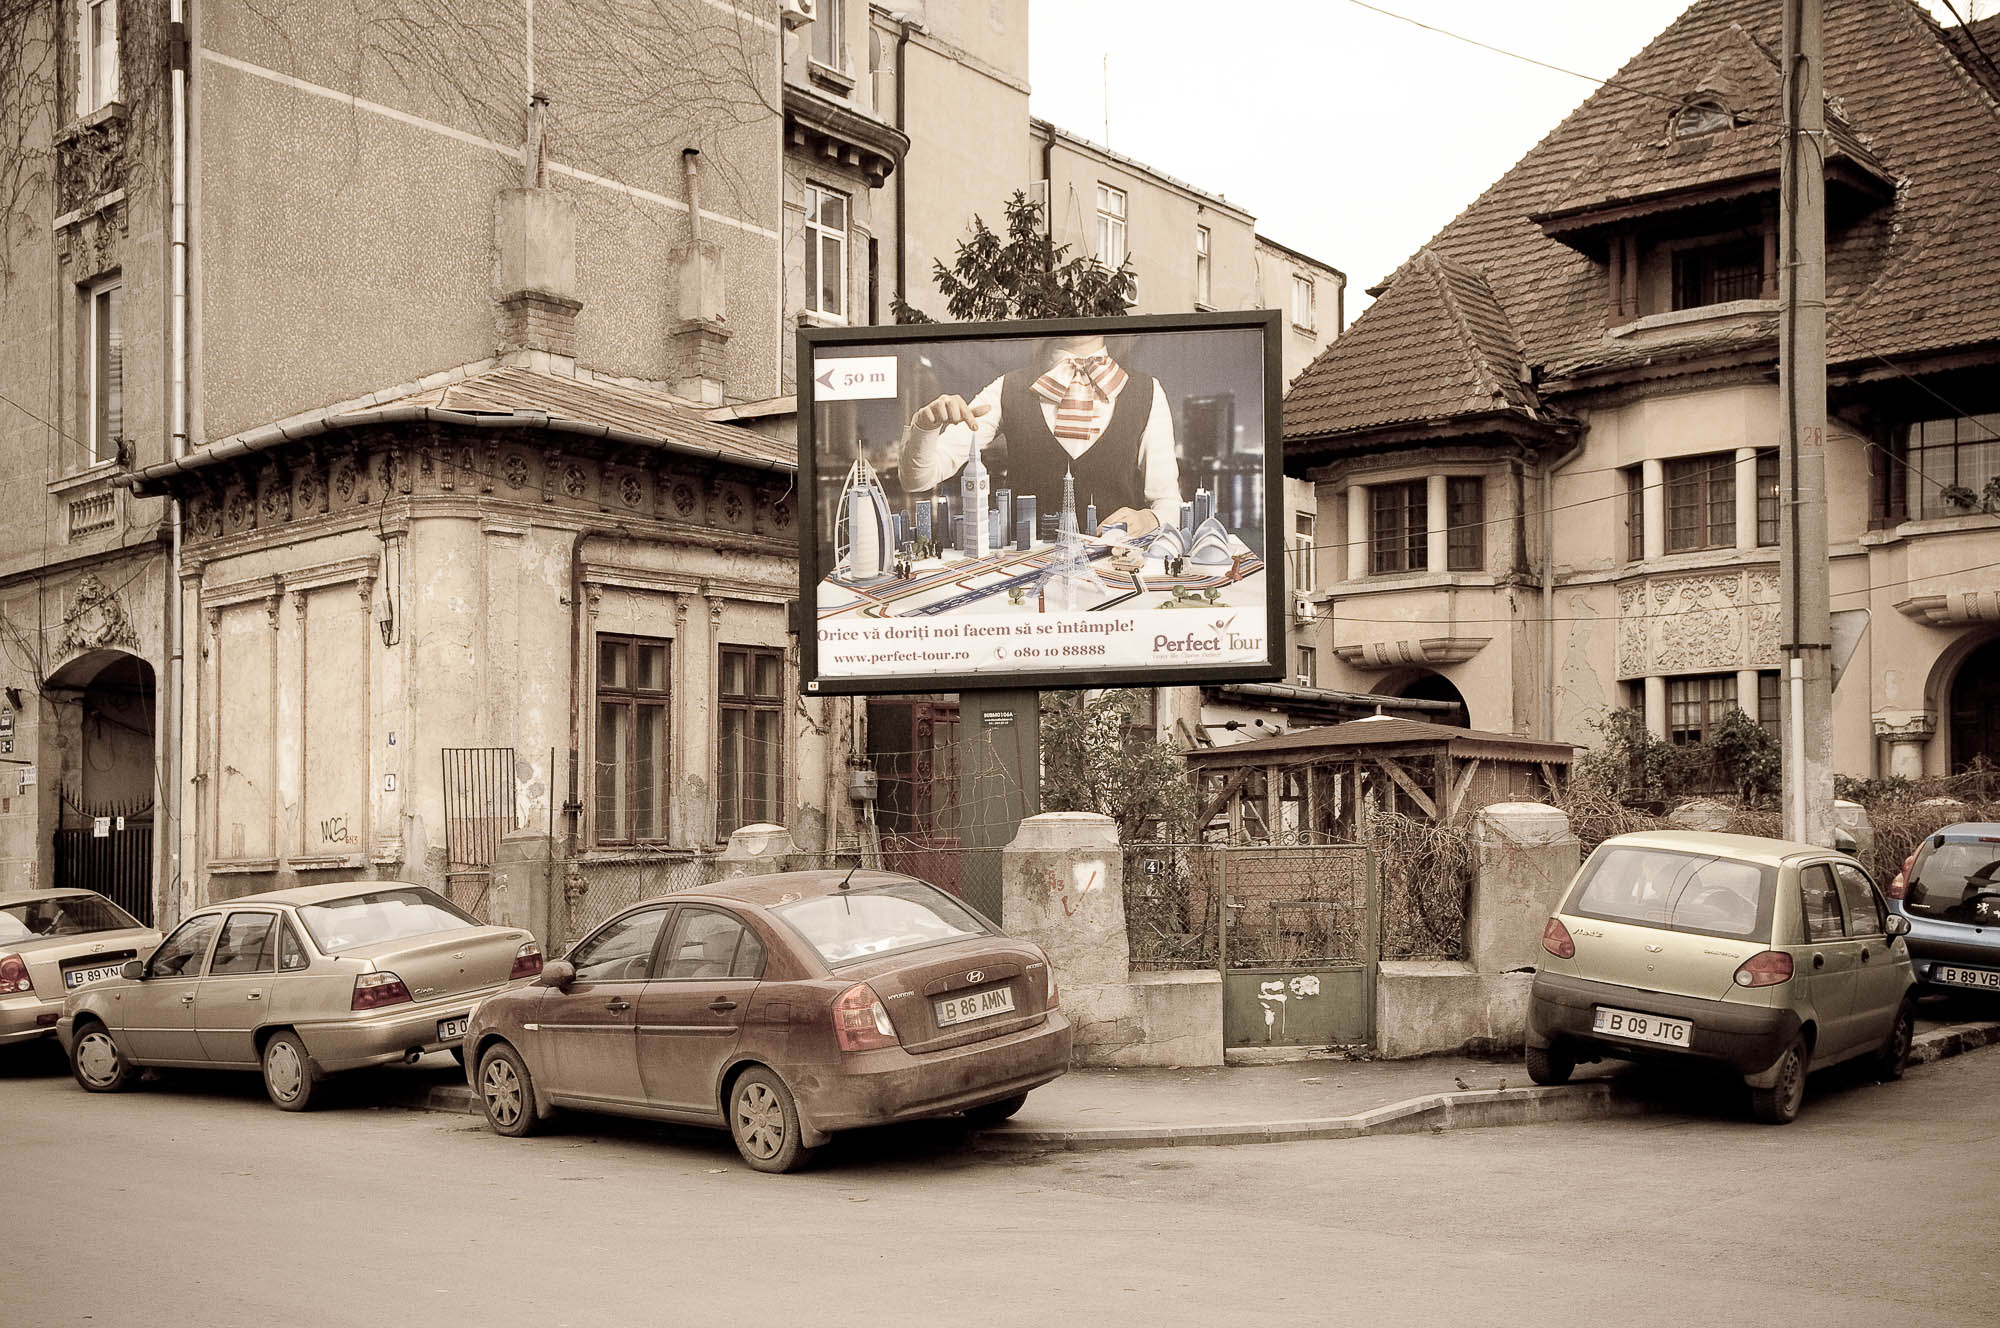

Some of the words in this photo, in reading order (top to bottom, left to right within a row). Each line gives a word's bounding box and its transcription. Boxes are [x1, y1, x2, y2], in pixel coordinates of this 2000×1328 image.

[844, 373, 864, 386] 50
[870, 373, 885, 382] m
[818, 628, 859, 642] Orice
[863, 628, 880, 640] vă
[885, 624, 929, 641] doriți
[934, 624, 959, 638] noi
[963, 623, 1011, 637] facem
[1015, 622, 1032, 635] să
[1036, 625, 1053, 635] se
[1057, 619, 1134, 635] întâmple!
[1153, 632, 1221, 652] Perfect
[1226, 632, 1262, 650] Tour
[834, 650, 970, 665] www.perfect-tour.ro
[1014, 647, 1040, 657] 080
[1045, 648, 1059, 657] 10
[1062, 645, 1106, 656] 88888
[1147, 861, 1156, 873] 4
[75, 972, 84, 983] B
[87, 970, 101, 981] 89
[1946, 969, 1956, 981] B
[1960, 970, 1976, 983] 89
[1980, 972, 2000, 986] VB
[945, 1003, 957, 1020] B
[961, 997, 977, 1016] 86
[982, 993, 1007, 1012] AMN
[447, 1022, 456, 1035] B
[460, 1018, 469, 1032] 0
[1610, 1014, 1623, 1030] B
[1628, 1017, 1647, 1034] 09
[1653, 1022, 1684, 1041] JTG
